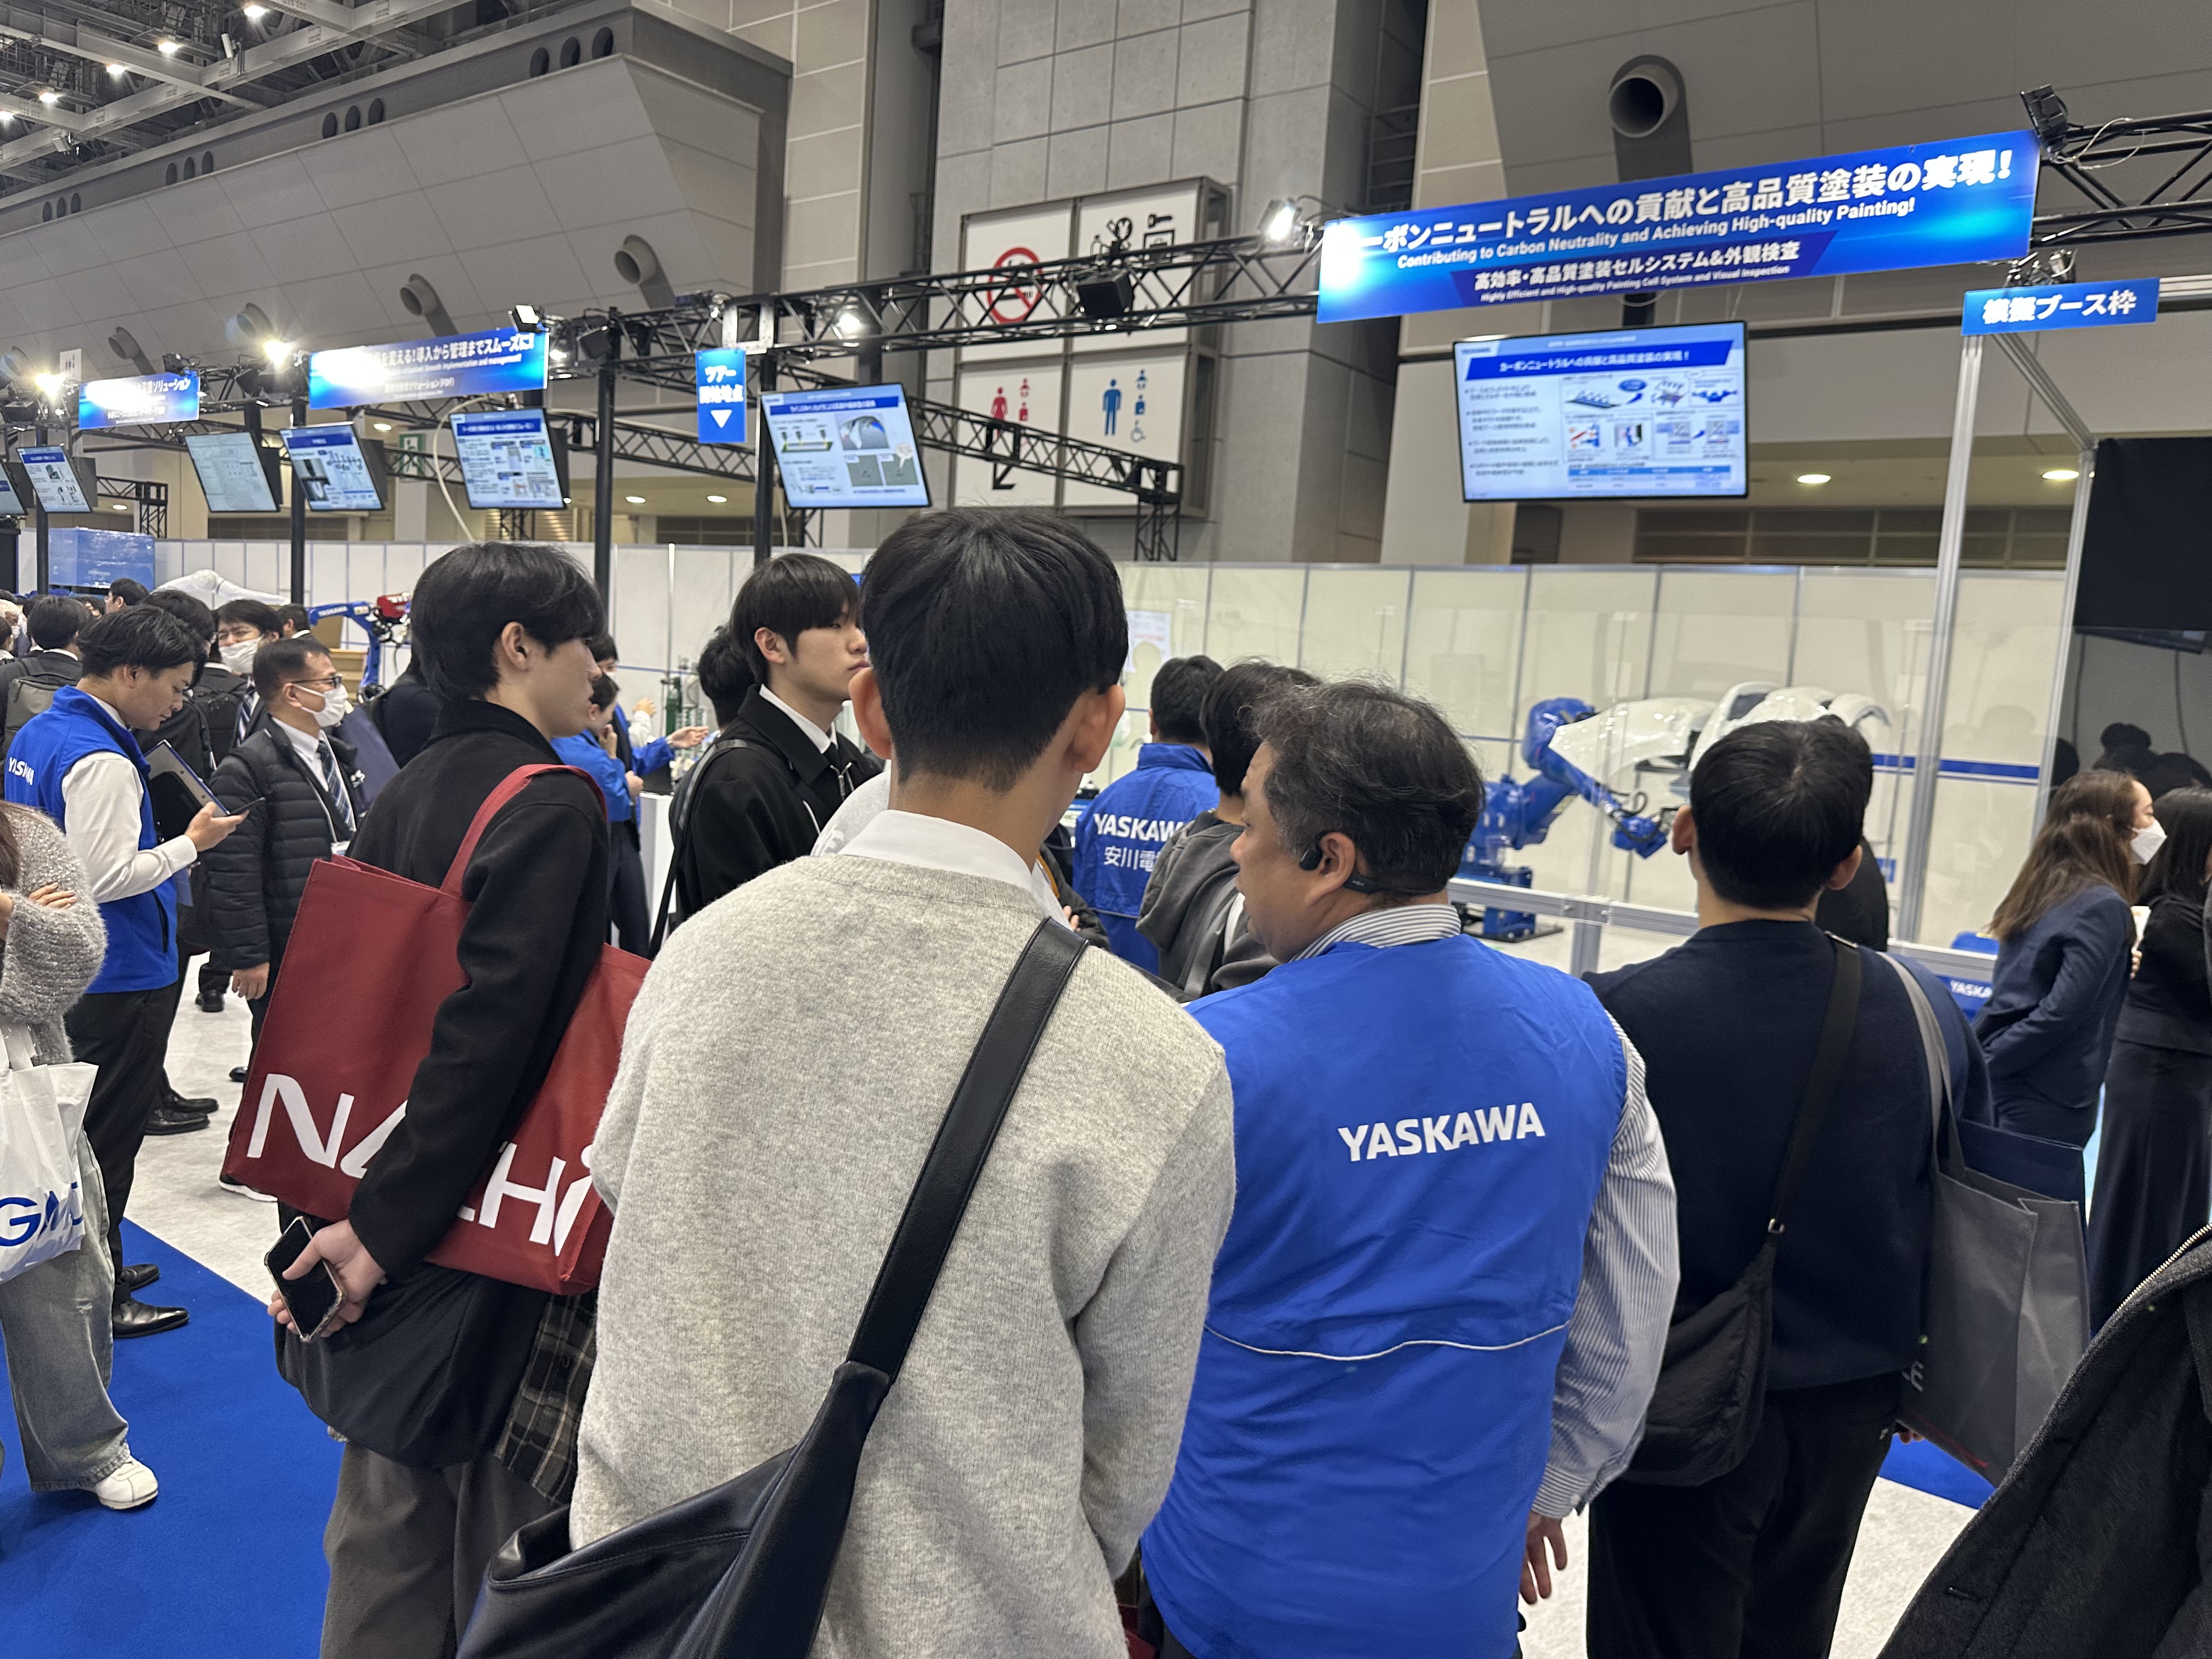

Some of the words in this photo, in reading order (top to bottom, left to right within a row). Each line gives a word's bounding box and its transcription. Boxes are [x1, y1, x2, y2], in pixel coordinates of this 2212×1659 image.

[1359, 149, 2013, 253] ーボンニュートラルへの貢献と高品質塗装の実現!
[1397, 246, 1477, 269] Contributing
[1480, 244, 1494, 259] to
[1496, 237, 1545, 257] Carbon
[1548, 232, 1618, 252] Neutrality
[1621, 227, 1647, 244] and
[1651, 220, 1727, 241] Achieving
[1731, 207, 1833, 232] High-quality
[1836, 197, 1915, 220] Painting!
[1481, 291, 1505, 302] Highly
[1506, 289, 1539, 300] Efficient
[1541, 286, 1555, 296] and
[1556, 282, 1605, 295] High-quality
[1606, 278, 1641, 290] Painting
[1642, 275, 1660, 286] Cell
[1661, 273, 1693, 286] System
[1694, 271, 1711, 282] and
[1713, 268, 1741, 280] Visual
[1742, 265, 1790, 279] Inspection
[705, 365, 737, 383] ツアー
[1093, 813, 1185, 842] YASKAW
[1103, 845, 1161, 872] 安川電
[1950, 980, 1993, 998] YASKA
[1337, 1102, 1546, 1162] YASKAWA
